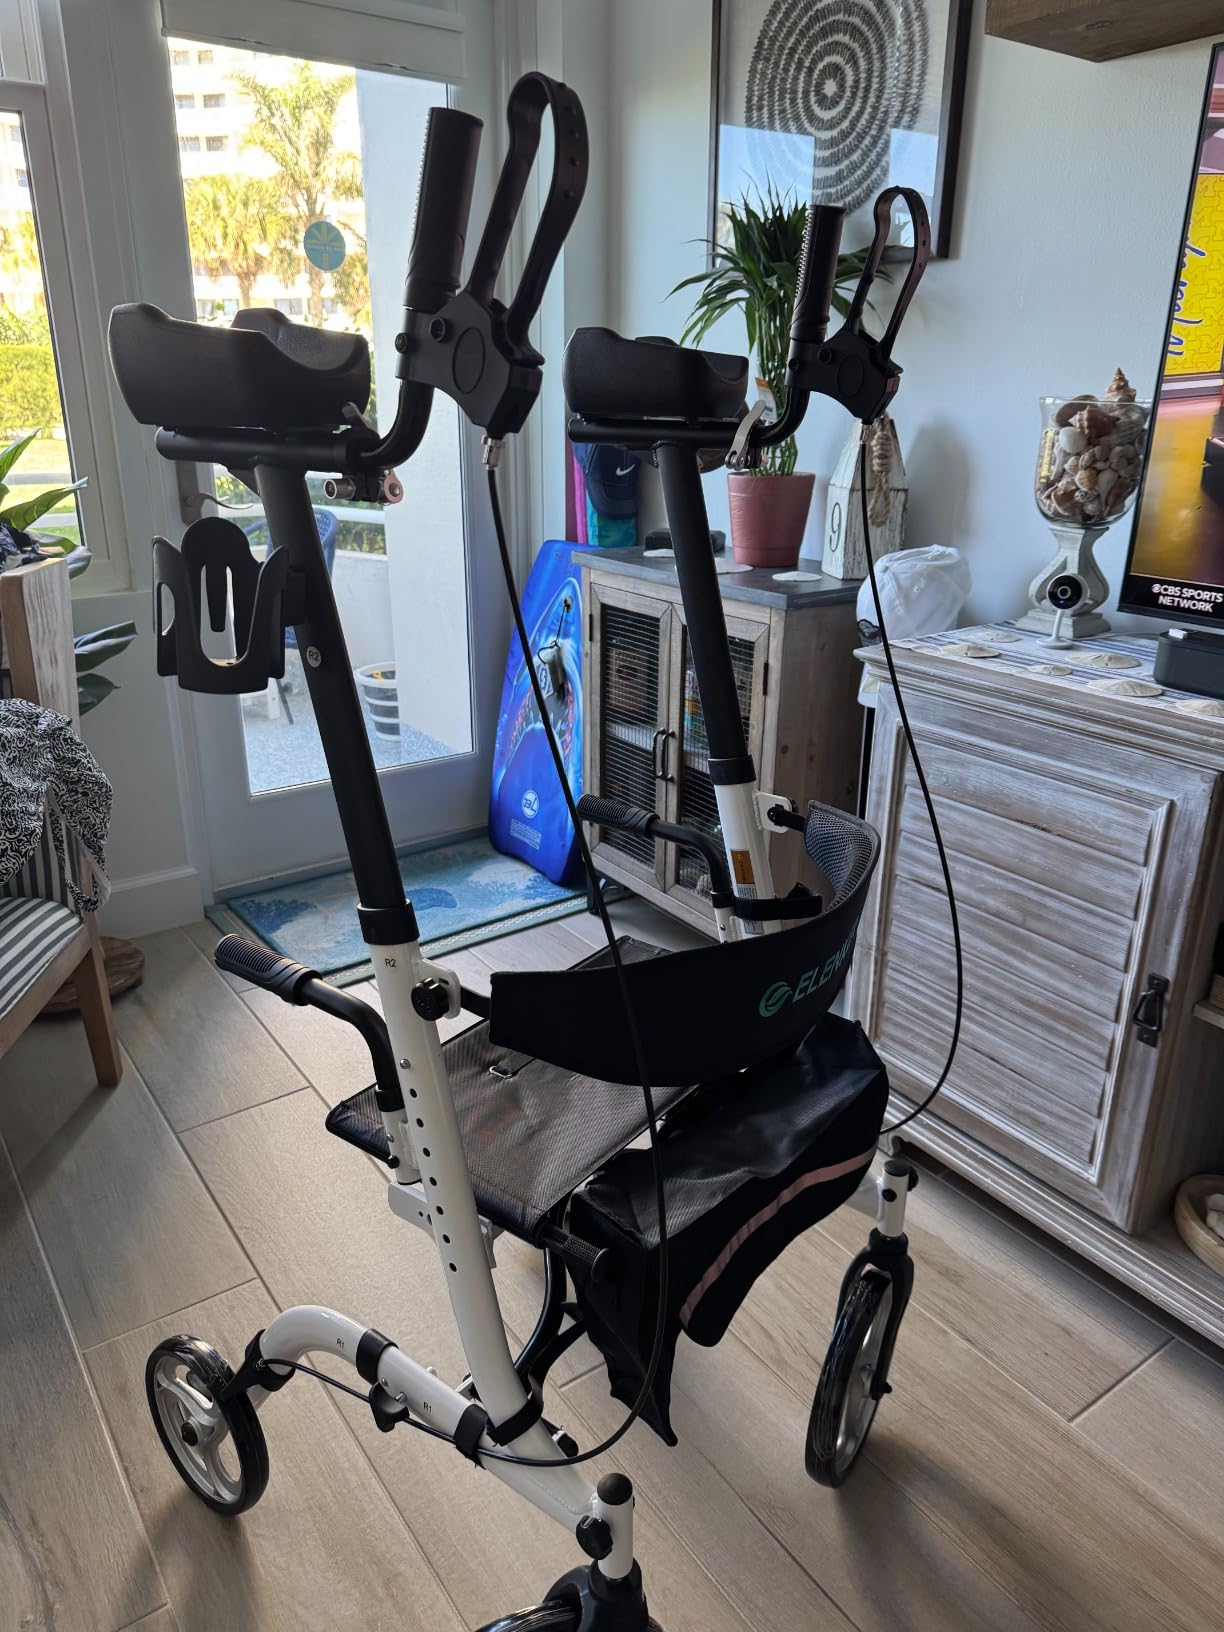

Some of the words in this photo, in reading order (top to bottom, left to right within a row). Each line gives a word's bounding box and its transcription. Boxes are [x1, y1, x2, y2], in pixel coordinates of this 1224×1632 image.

[830, 502, 842, 553] 9
[1160, 585, 1182, 597] CBS
[1181, 588, 1223, 603] SPORTS
[1158, 595, 1214, 612] NETWORK
[309, 650, 320, 662] R2
[384, 958, 397, 968] R2
[336, 1338, 345, 1349] R1
[423, 1401, 432, 1413] R1
